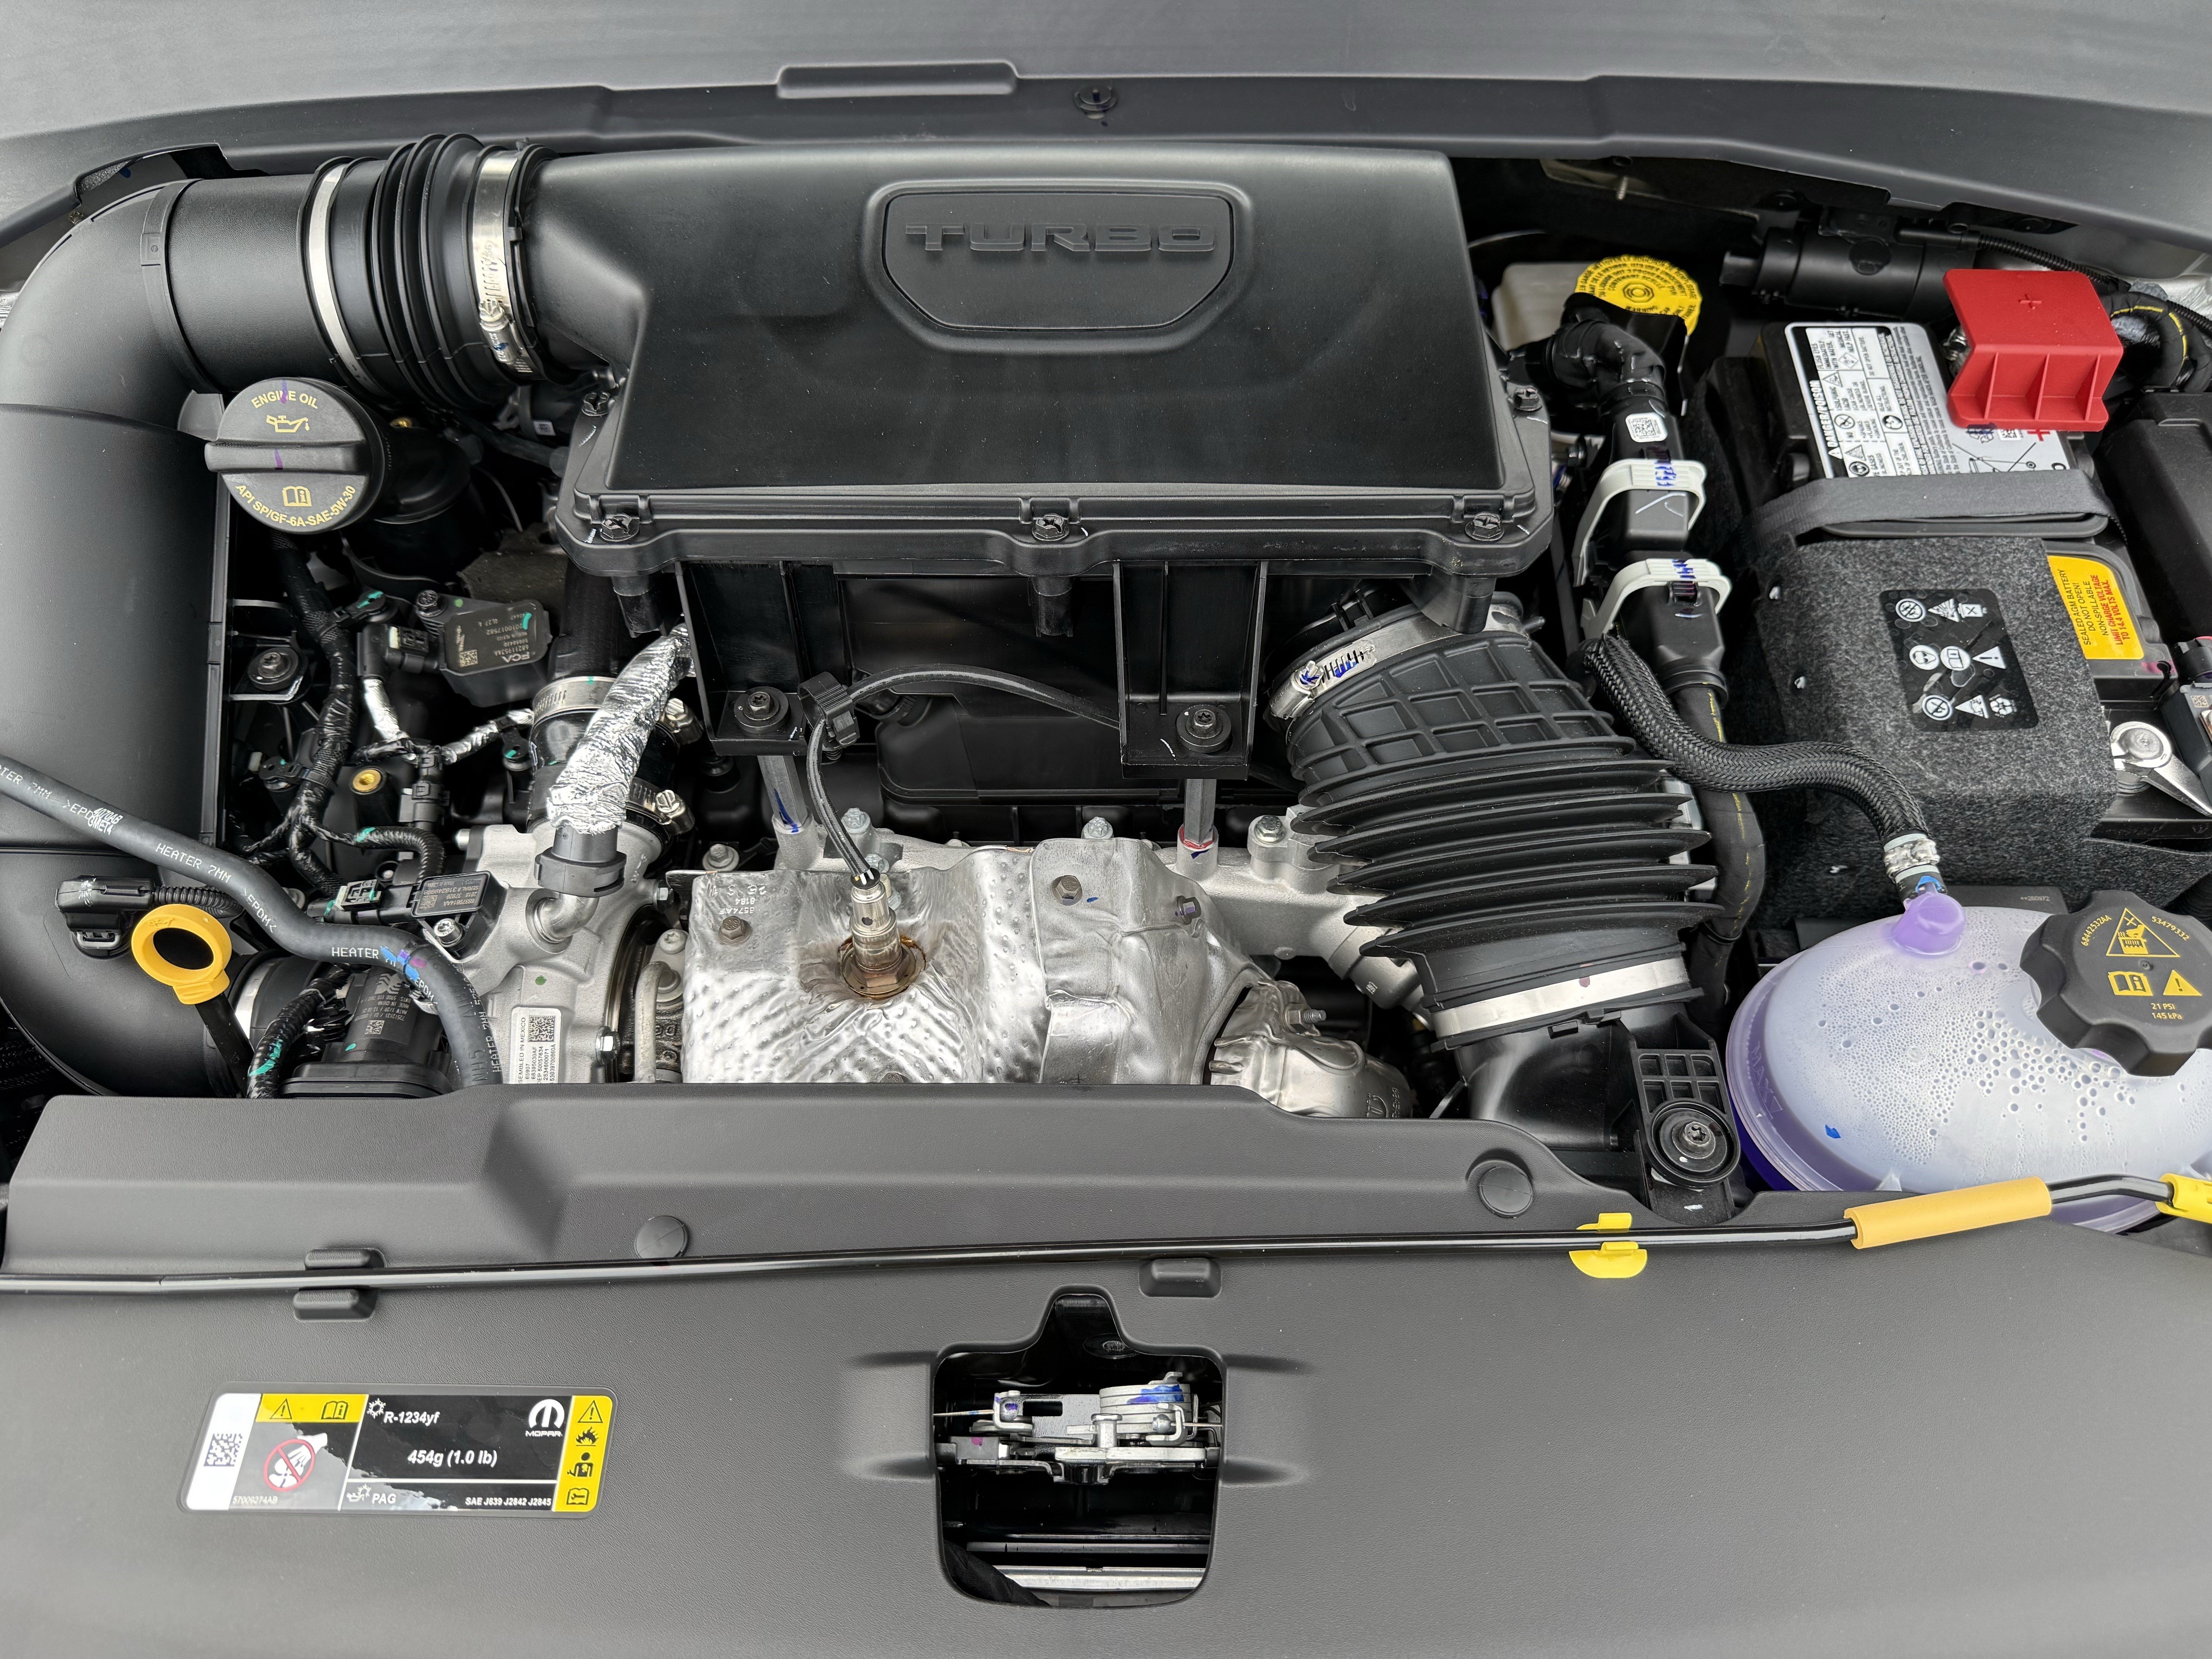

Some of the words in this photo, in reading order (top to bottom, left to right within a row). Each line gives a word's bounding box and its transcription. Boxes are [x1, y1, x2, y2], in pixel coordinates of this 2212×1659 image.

[905, 223, 1216, 251] TURBO
[299, 393, 318, 409] OIL
[235, 484, 254, 504] API
[2057, 569, 2075, 599] BATTERY
[2071, 582, 2086, 603] OPEN!
[2089, 575, 2107, 601] VOLTAGE
[2100, 580, 2114, 595] MAX.
[2068, 601, 2081, 616] AGM
[2080, 605, 2092, 619] NOT
[2081, 581, 2110, 635] NON-SPILLABLE
[2106, 597, 2121, 615] VOLTS
[2100, 603, 2117, 627] CHARGE
[2114, 617, 2126, 629] 14.4
[2075, 618, 2092, 645] SEALED
[2085, 622, 2096, 631] DO
[2110, 629, 2124, 644] LIMIT
[501, 651, 530, 663] FCA
[155, 843, 202, 869] HEATER
[208, 865, 233, 883] 7MM
[2151, 915, 2190, 941] 53479332
[332, 947, 379, 959] HEATER
[384, 1411, 440, 1426] R-1234yf
[407, 1450, 443, 1467] 454g
[447, 1450, 474, 1468] (1.0
[478, 1450, 498, 1468] lb)
[372, 1493, 396, 1504] PAG
[465, 1498, 483, 1506] SAE
[503, 1498, 527, 1506] J2842
[528, 1498, 551, 1506] J2845
